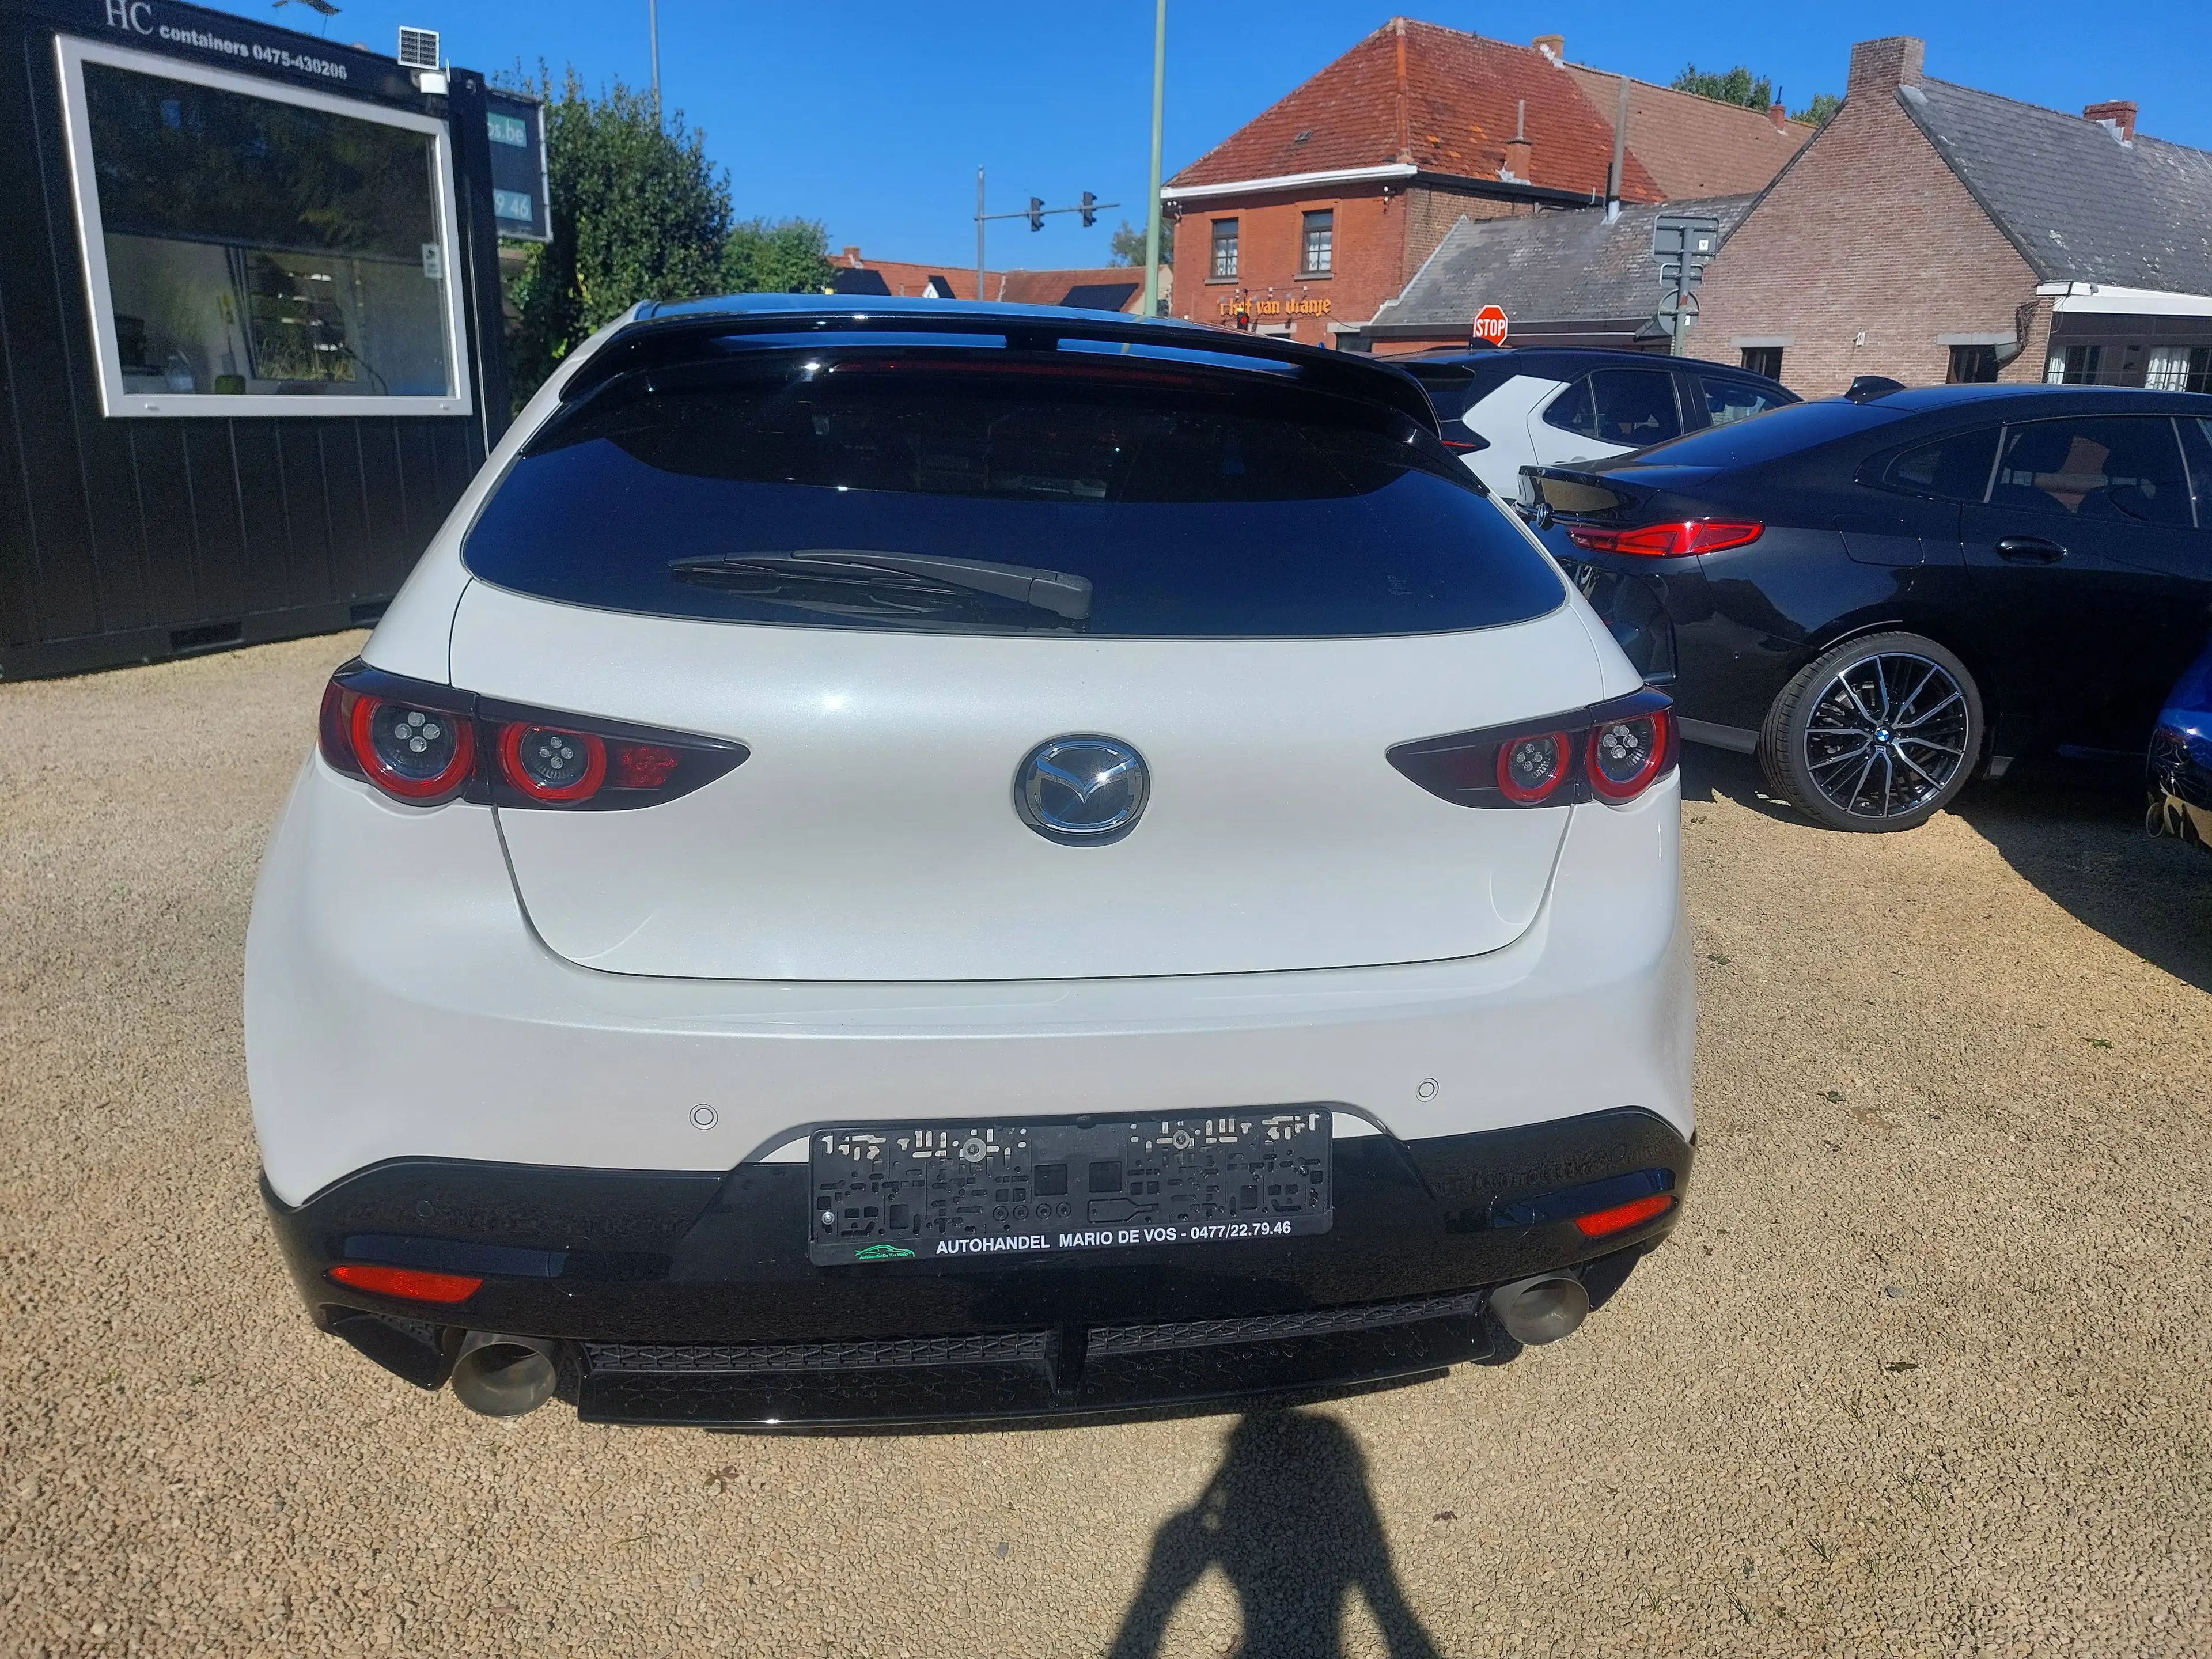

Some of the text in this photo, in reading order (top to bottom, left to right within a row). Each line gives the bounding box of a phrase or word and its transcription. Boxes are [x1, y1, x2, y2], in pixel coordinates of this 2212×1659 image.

[105, 0, 347, 80] HC containers 0475-430206
[510, 196, 529, 218] 46
[1256, 301, 1279, 315] van
[1476, 319, 1506, 337] STOP
[935, 1235, 1051, 1255] AUTOHANDEL
[1059, 1230, 1113, 1248] MARIO
[1118, 1228, 1139, 1244] DE
[1143, 1226, 1177, 1243] VOS
[1190, 1221, 1291, 1240] 0477/22.79.46
